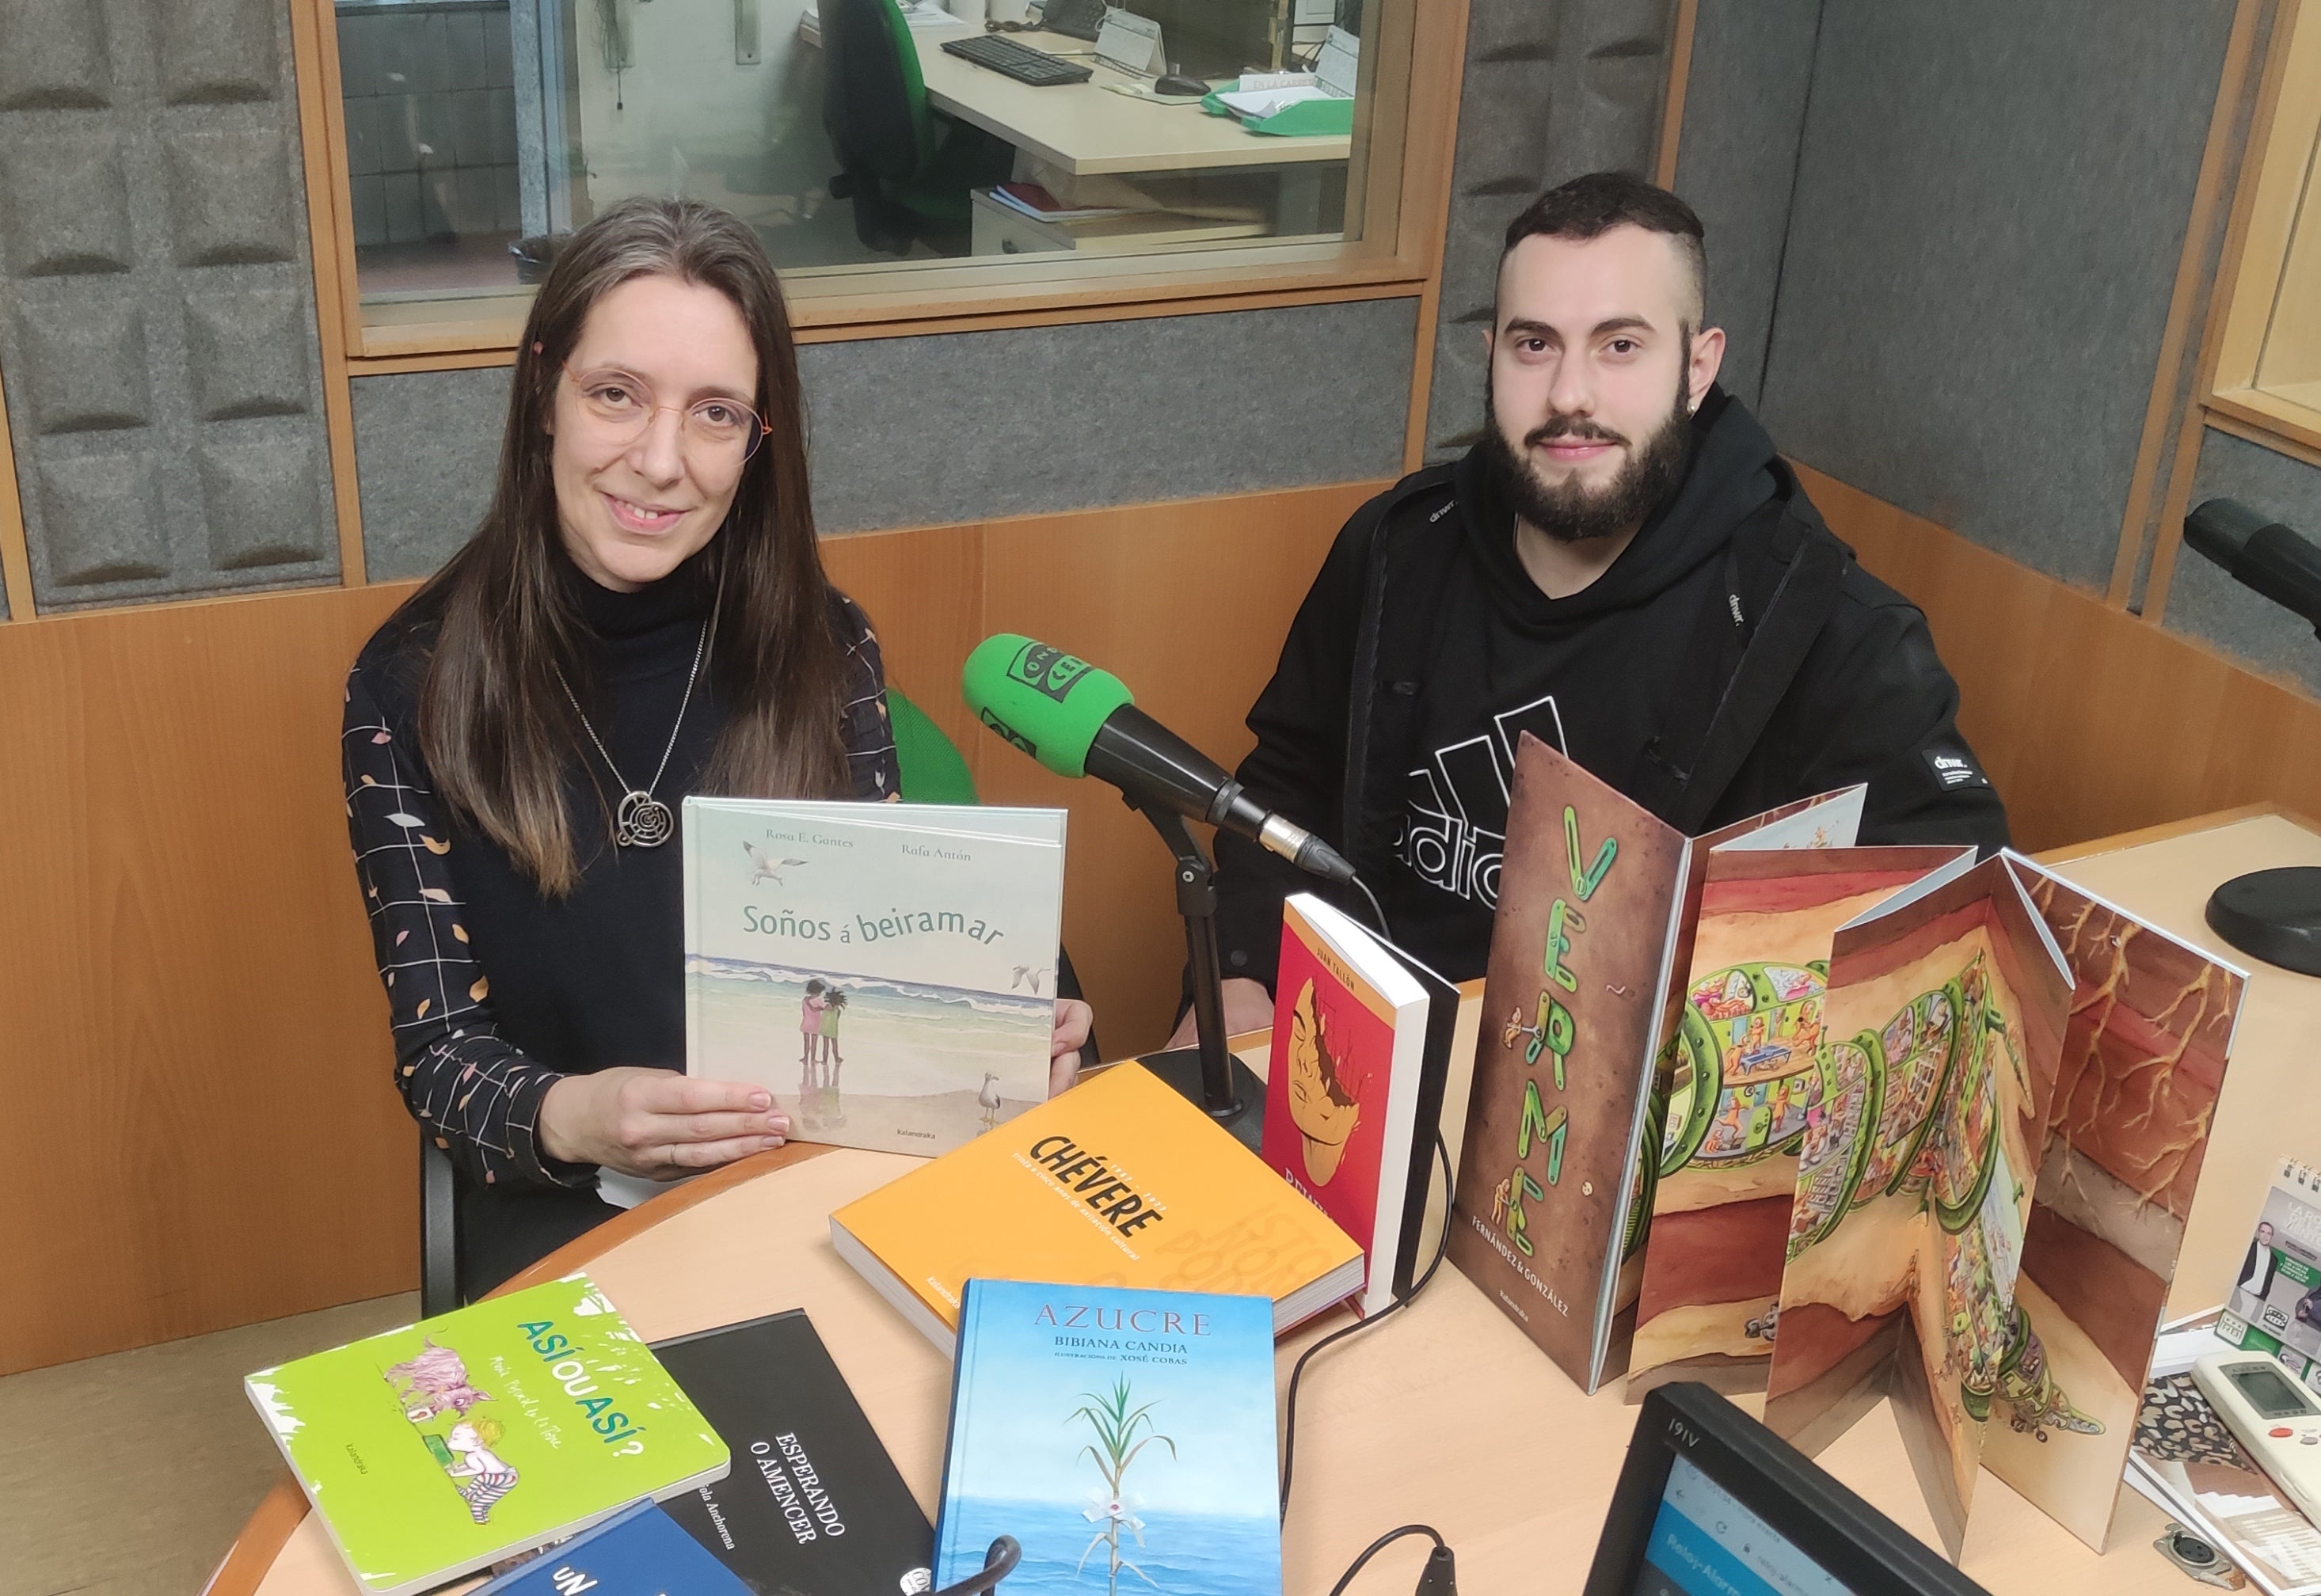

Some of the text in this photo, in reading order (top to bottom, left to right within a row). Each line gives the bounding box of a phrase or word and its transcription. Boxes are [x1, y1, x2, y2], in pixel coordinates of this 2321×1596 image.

[766, 829, 854, 849] Rosa E. Gantes
[901, 844, 972, 862] Rafa Antón
[742, 906, 1004, 947] Soños á beiramar
[1029, 1135, 1164, 1238] CHÉVERE
[1110, 1234, 1140, 1261] cultural
[1471, 1215, 1518, 1267] FERNÁNDEZ
[1524, 1268, 1570, 1318] GONZÁLEZ
[1033, 1303, 1212, 1336] AZUCRE
[516, 1321, 586, 1362] ASÍ
[552, 1360, 599, 1397] OU
[1054, 1336, 1189, 1355] BIBIANA CANDIA
[1120, 1354, 1150, 1363] XOSÉ
[1151, 1356, 1189, 1366] COBAS
[756, 1457, 818, 1545] AMENCER
[774, 1432, 846, 1538] ESPERANDO
[706, 1503, 736, 1551] Anchorena
